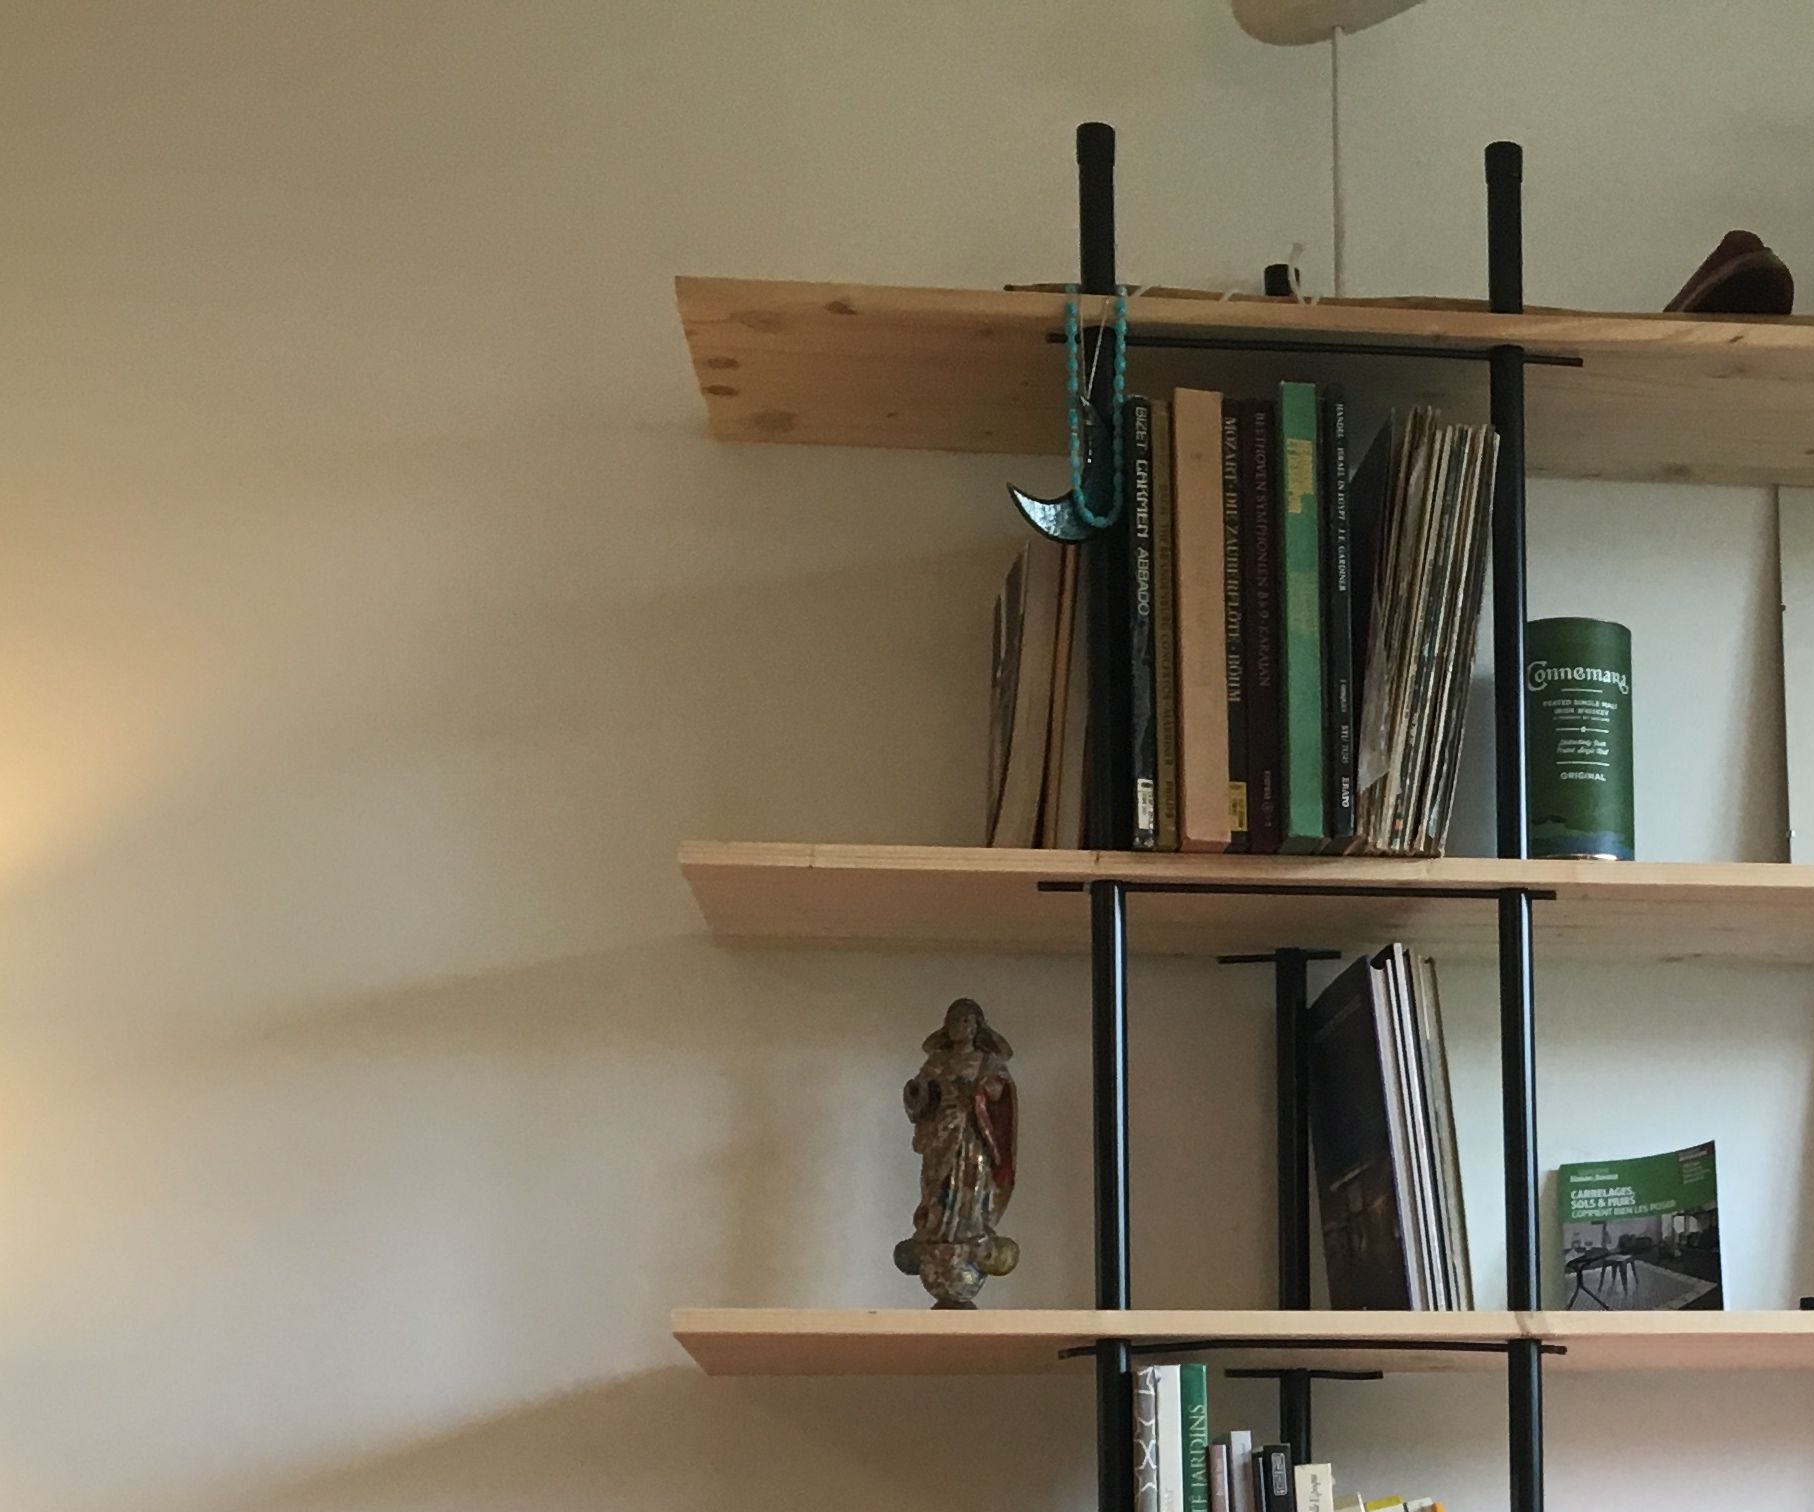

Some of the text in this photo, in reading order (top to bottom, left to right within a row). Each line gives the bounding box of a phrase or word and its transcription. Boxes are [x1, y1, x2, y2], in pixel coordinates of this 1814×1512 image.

[1224, 416, 1240, 481] MOZART
[1255, 412, 1269, 490] BEETHOVEN
[1134, 406, 1151, 617] BIZET CARMEN ABBADO
[1336, 492, 1348, 521] EGYPT
[1256, 495, 1271, 587] SYMPHONIEN
[1337, 545, 1348, 593] GARDINER
[1227, 653, 1244, 703] BÖHM
[1258, 625, 1273, 688] KARAJAN
[1527, 660, 1630, 695] Connemara
[1341, 777, 1352, 809] ERATO
[1560, 771, 1607, 782] ORIGINAL
[1571, 1198, 1596, 1211] SOLS
[1598, 1199, 1607, 1208] &
[1189, 1403, 1209, 1488] JARDINS
